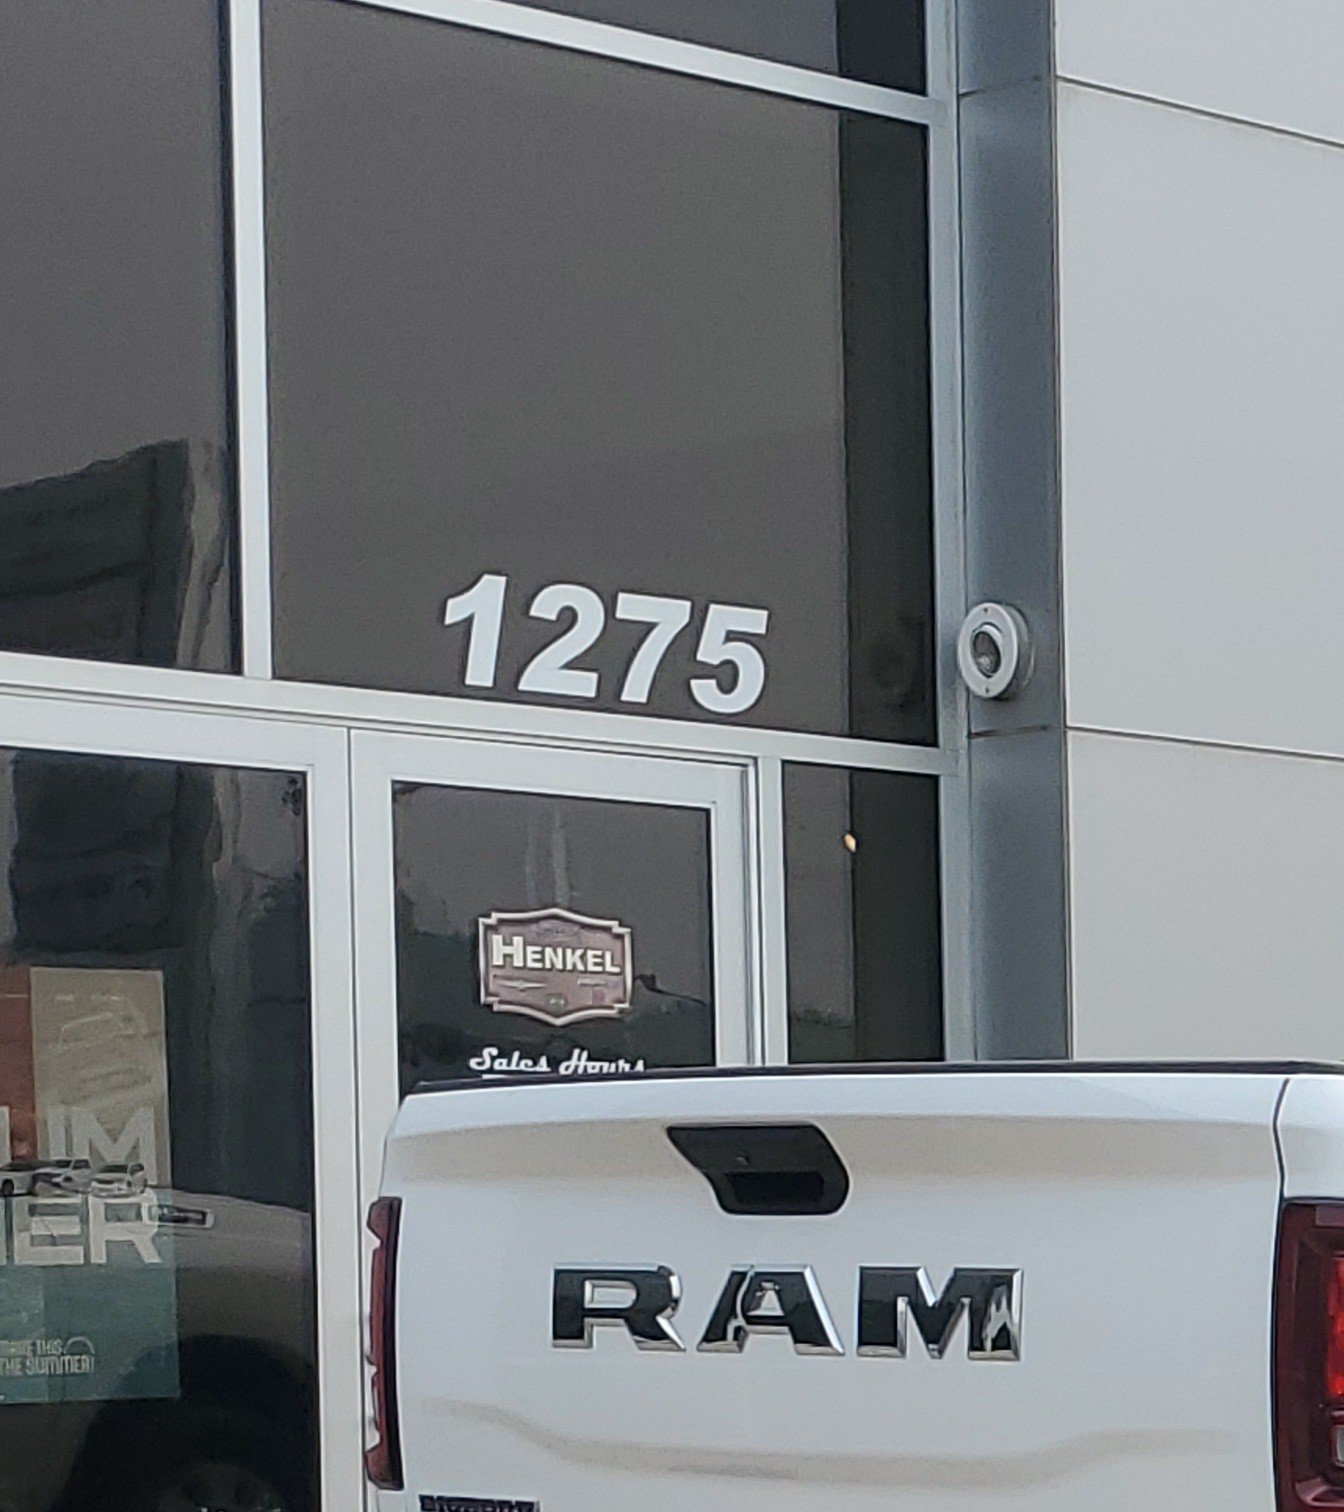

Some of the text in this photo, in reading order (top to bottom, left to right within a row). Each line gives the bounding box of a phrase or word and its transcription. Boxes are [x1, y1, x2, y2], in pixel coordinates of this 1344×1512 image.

[443, 573, 770, 714] 1275
[491, 934, 621, 973] HENKEL
[468, 1046, 645, 1075] Sales Hours
[550, 1263, 1025, 1361] RAM
